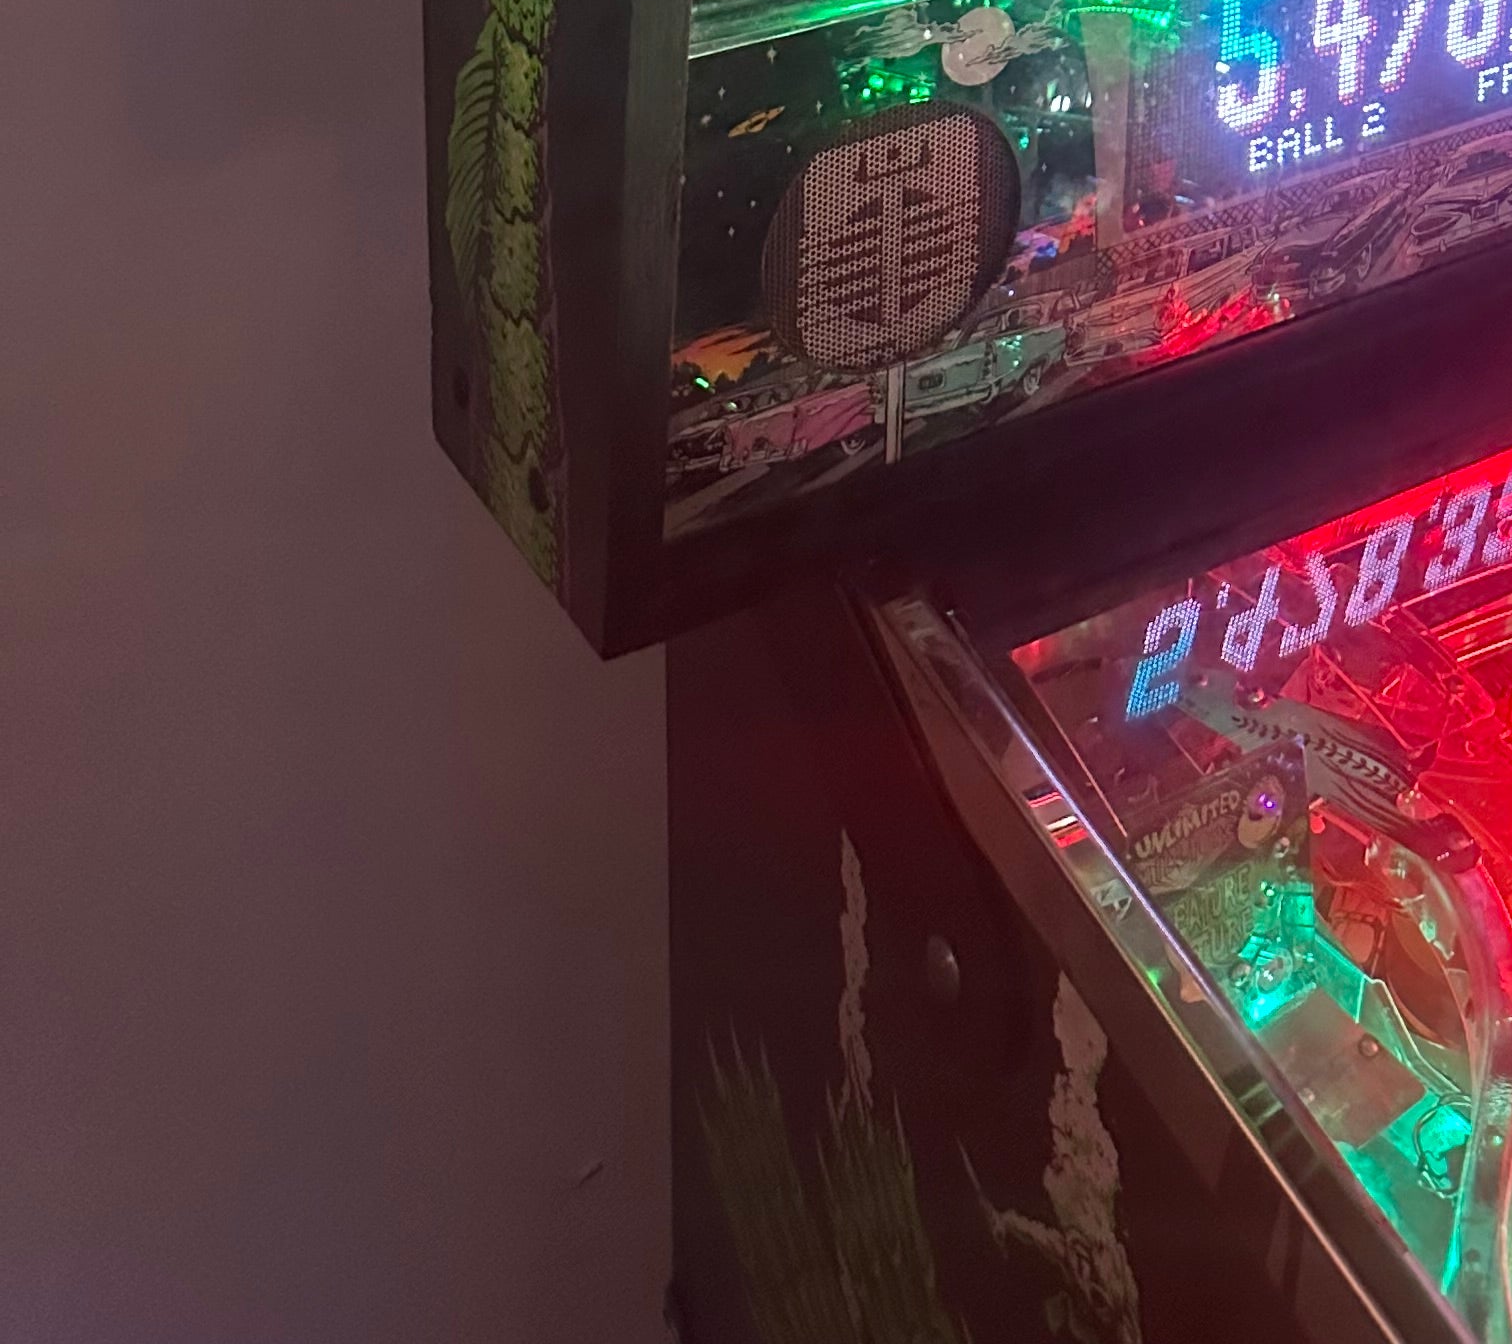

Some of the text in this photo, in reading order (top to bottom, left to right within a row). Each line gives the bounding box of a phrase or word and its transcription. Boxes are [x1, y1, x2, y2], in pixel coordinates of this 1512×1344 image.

[1248, 117, 1344, 174] BALL
[1362, 103, 1387, 138] 2
[1134, 789, 1241, 859] UNLIMITED
